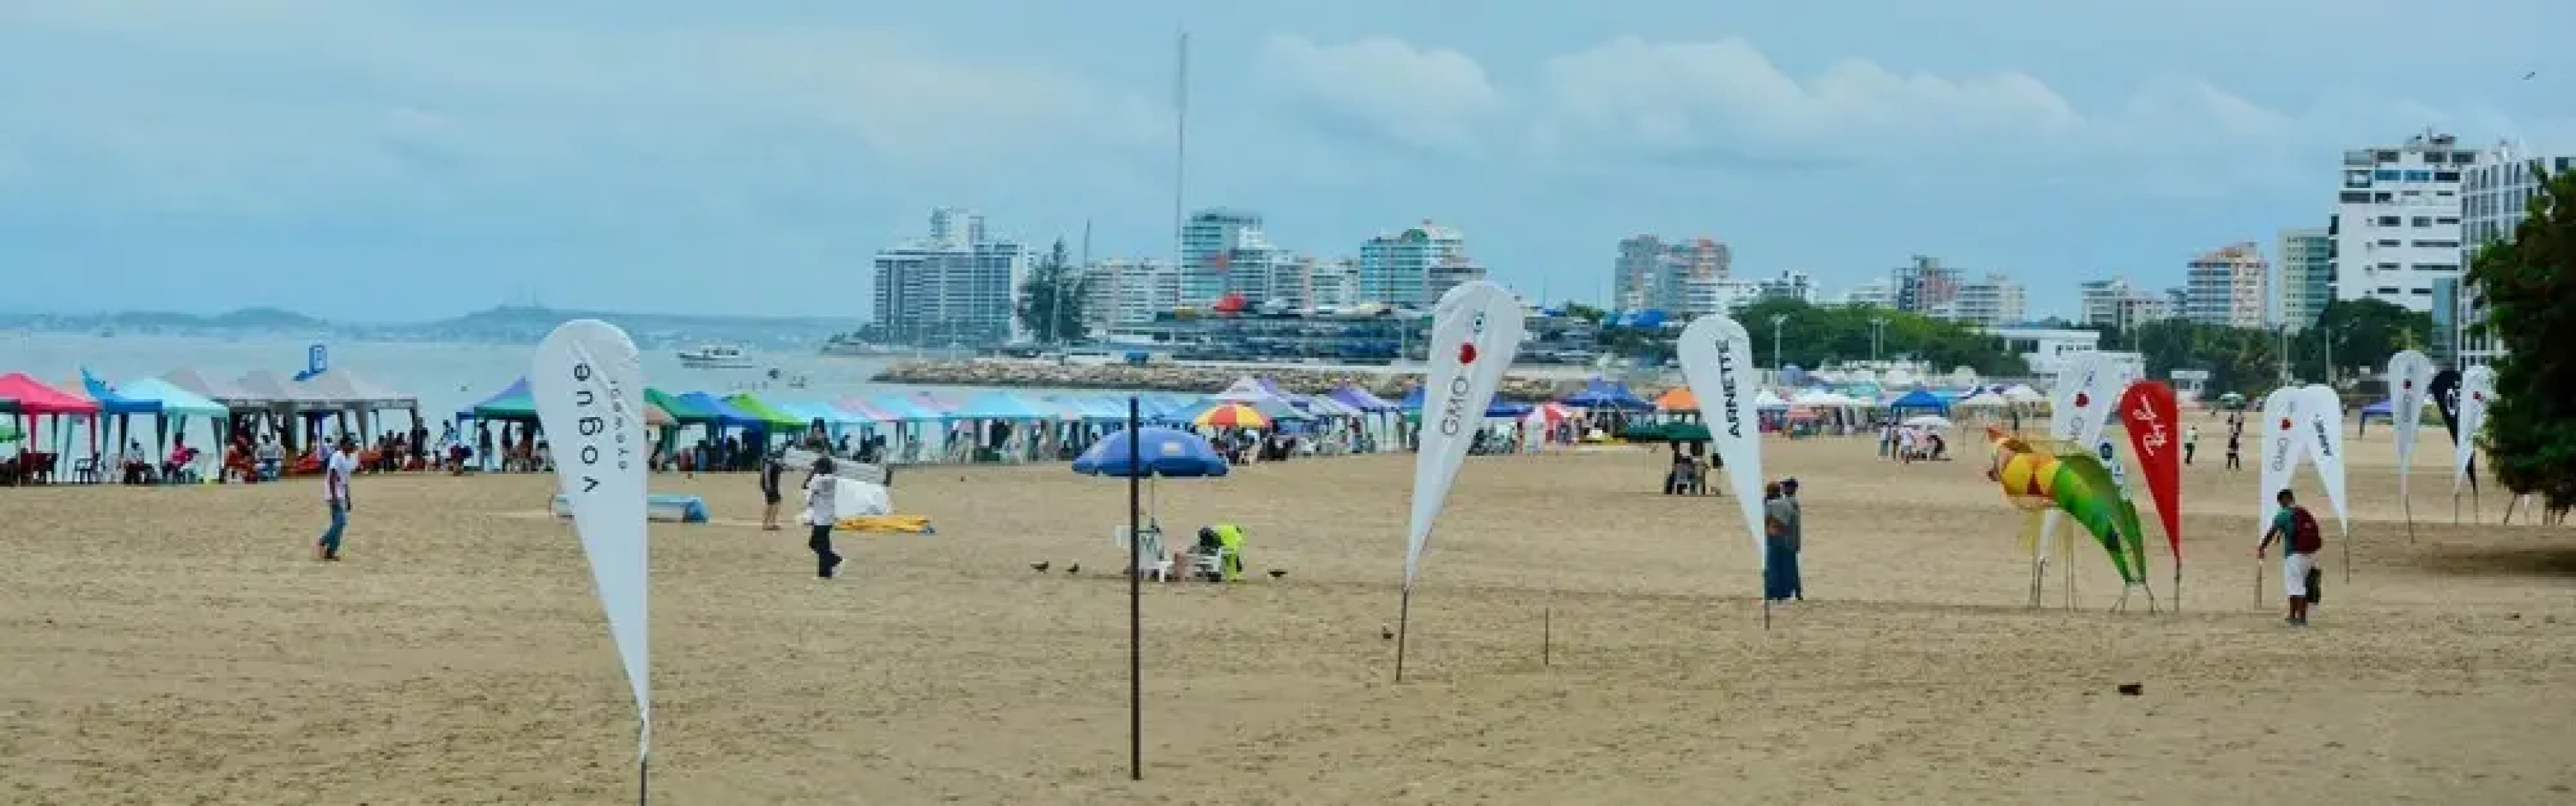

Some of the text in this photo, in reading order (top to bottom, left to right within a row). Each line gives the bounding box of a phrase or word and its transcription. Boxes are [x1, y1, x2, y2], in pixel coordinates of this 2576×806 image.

[574, 363, 603, 493] vogue
[1442, 375, 1469, 437] GMO
[1716, 340, 1742, 438] ARNETTE
